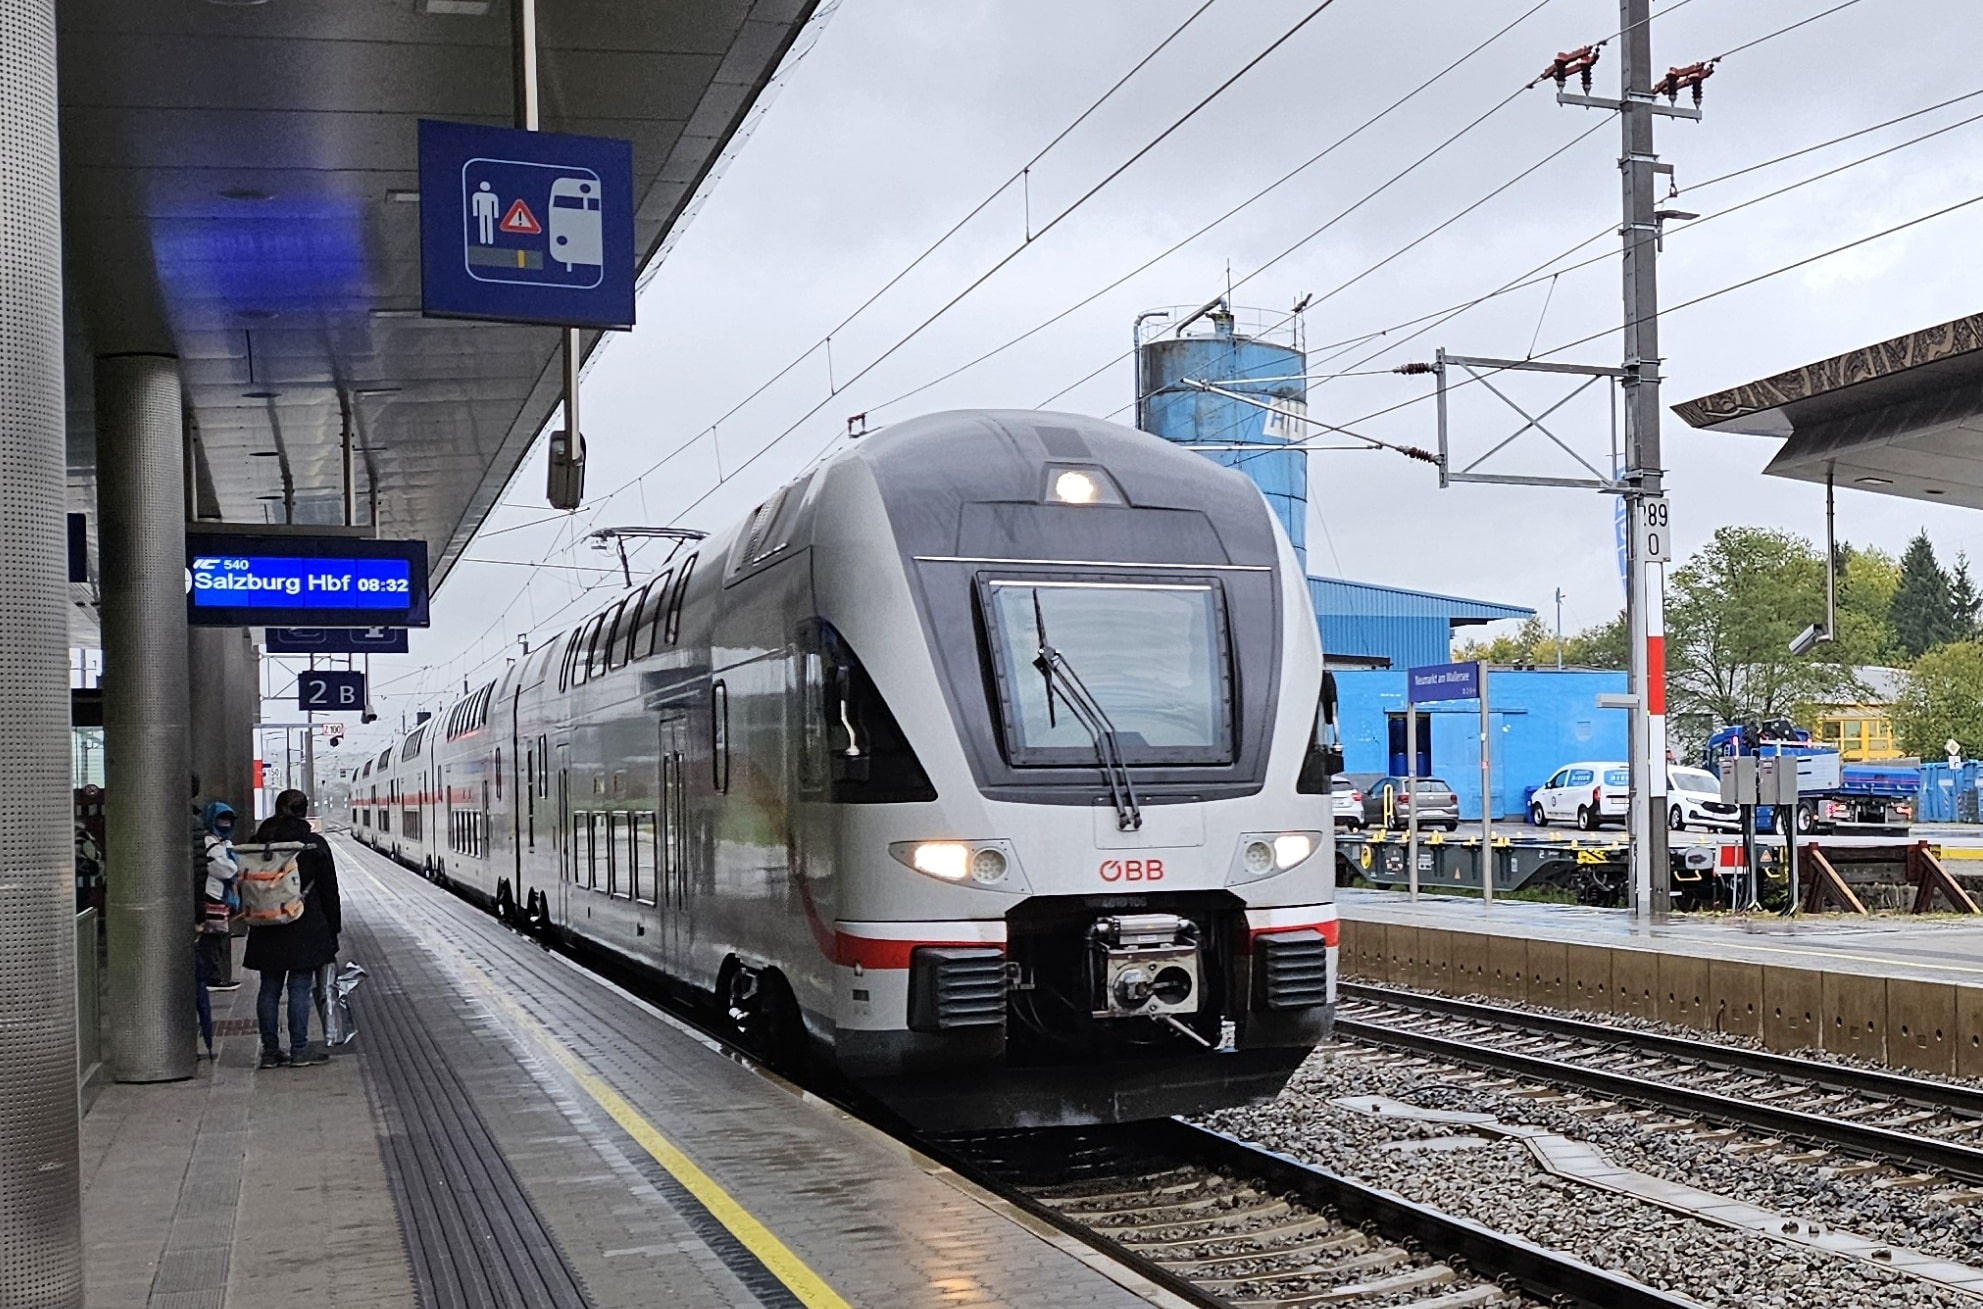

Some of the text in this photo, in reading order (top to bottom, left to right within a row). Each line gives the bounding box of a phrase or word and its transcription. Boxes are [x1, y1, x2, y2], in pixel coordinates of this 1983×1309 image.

[1644, 503, 1668, 527] 89
[223, 559, 249, 570] 540
[195, 572, 409, 594] Salzburg Hbf 08:32
[309, 680, 355, 704] 2 B
[1100, 859, 1164, 882] ÖBB
